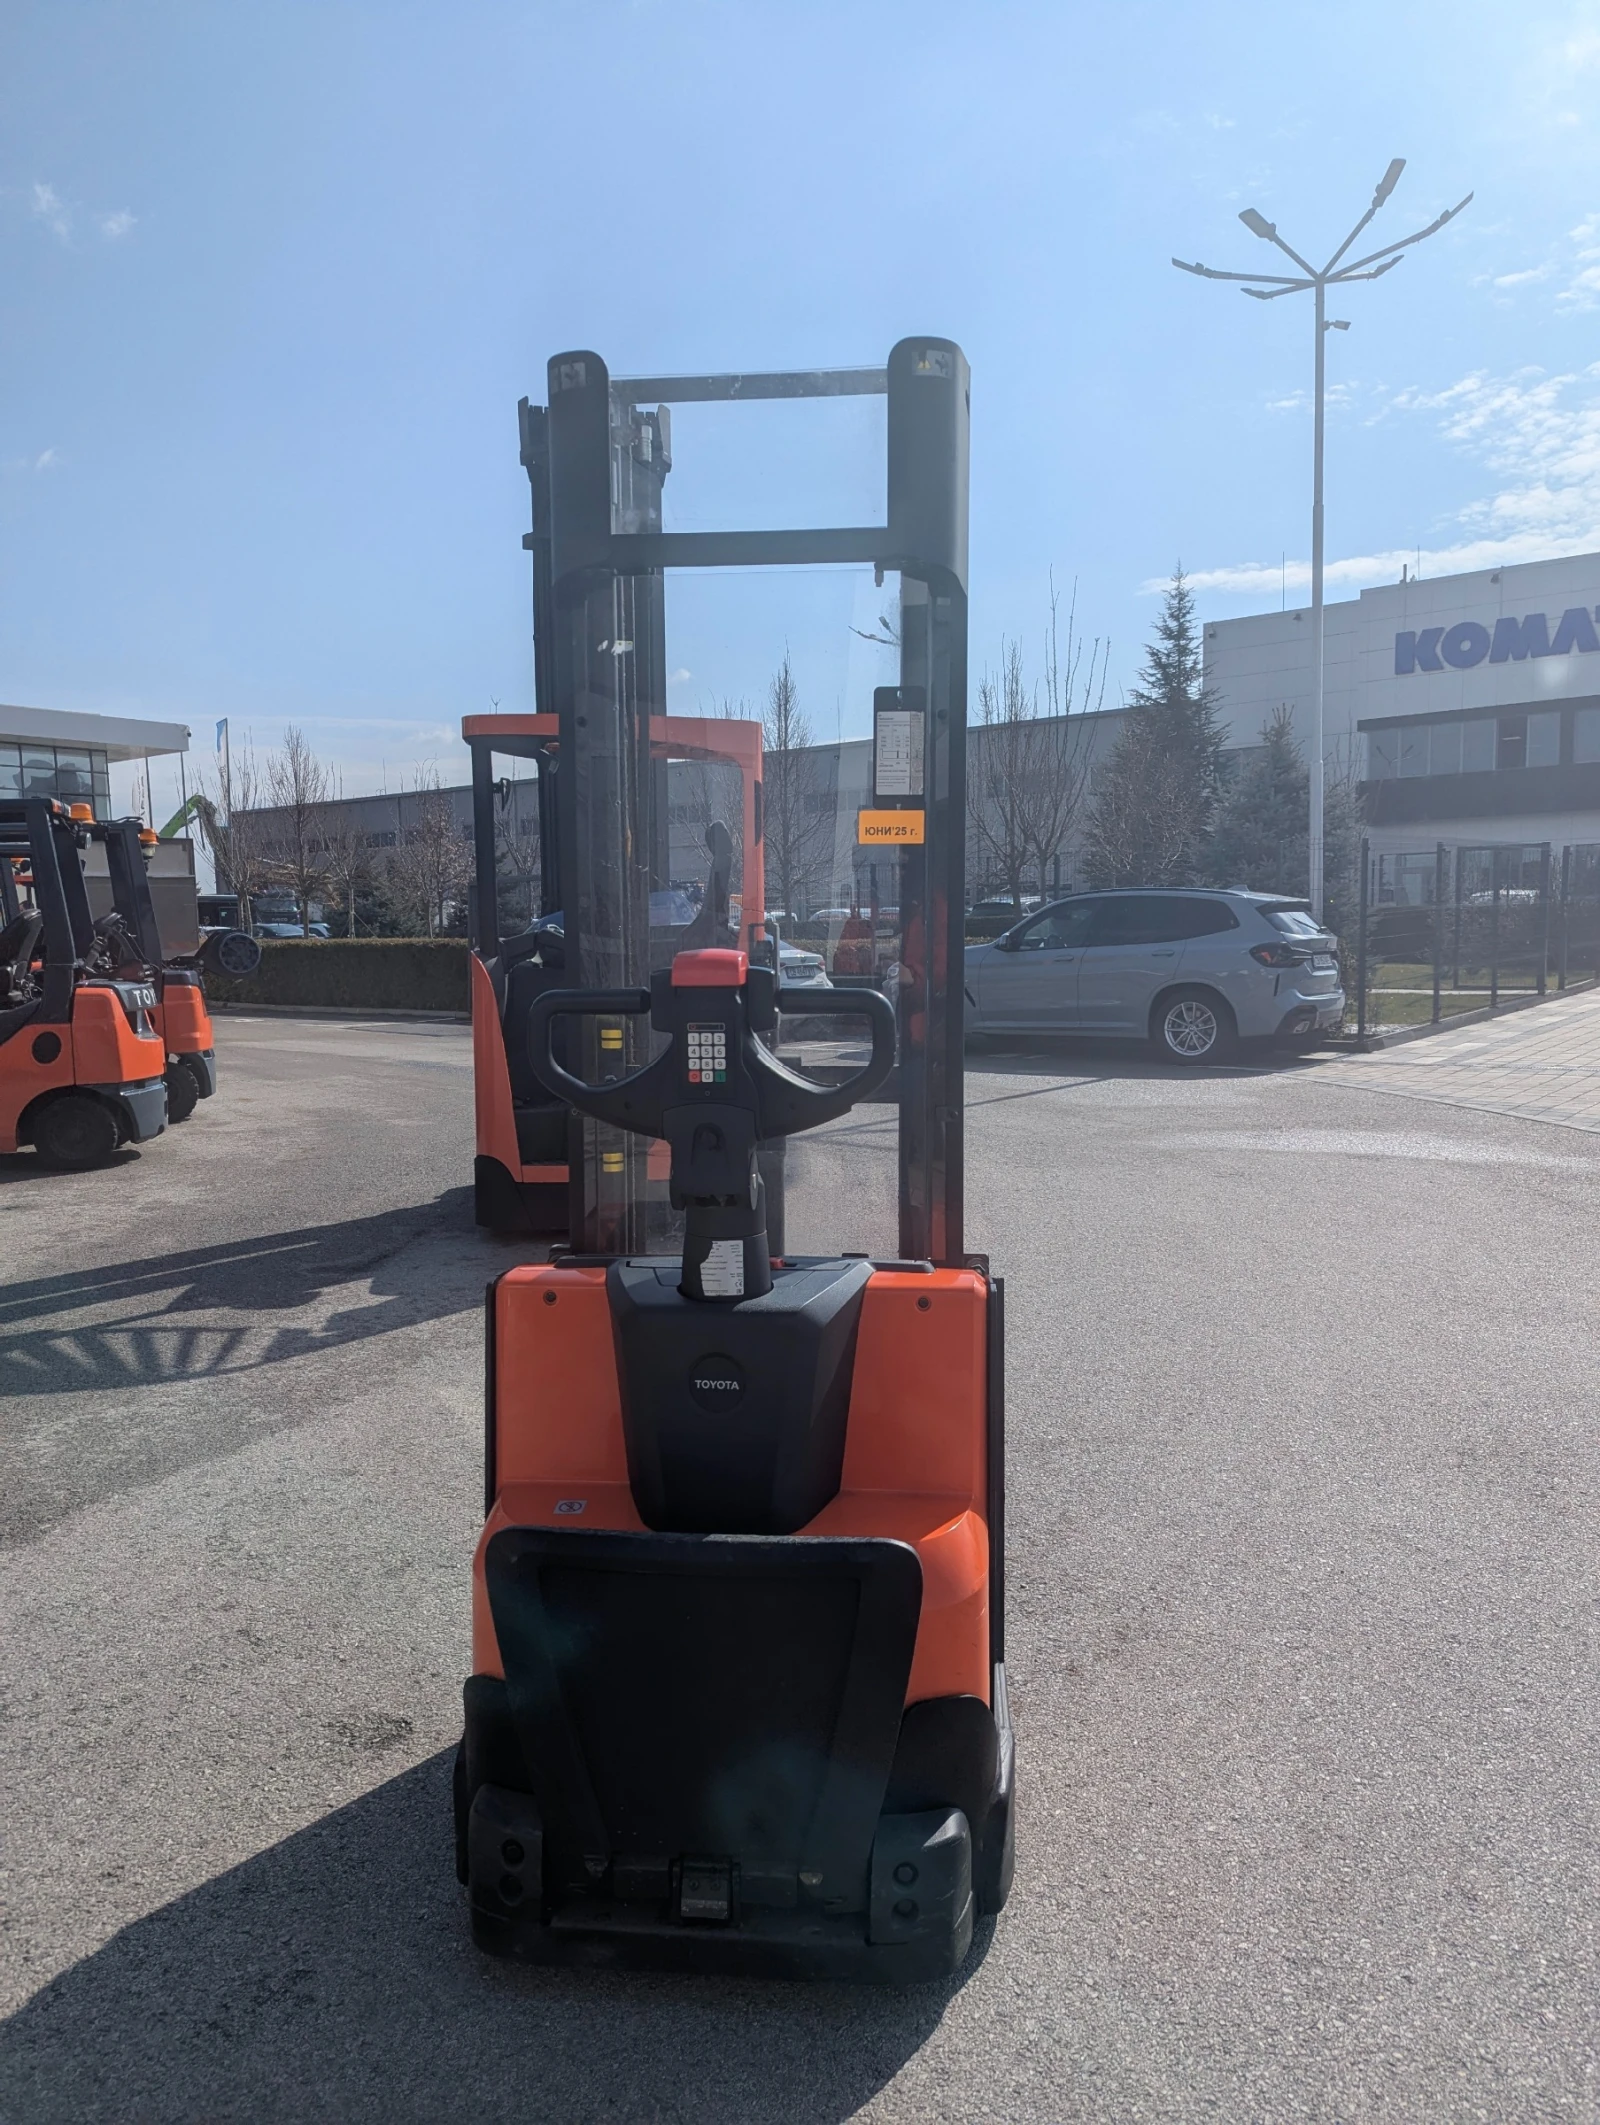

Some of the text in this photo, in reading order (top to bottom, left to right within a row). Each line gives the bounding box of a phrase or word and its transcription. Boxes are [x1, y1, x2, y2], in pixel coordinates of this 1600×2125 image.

[1395, 604, 1600, 675] KOMA
[864, 826, 908, 836] ЮНИ'25
[694, 1379, 740, 1390] TOYOTA
